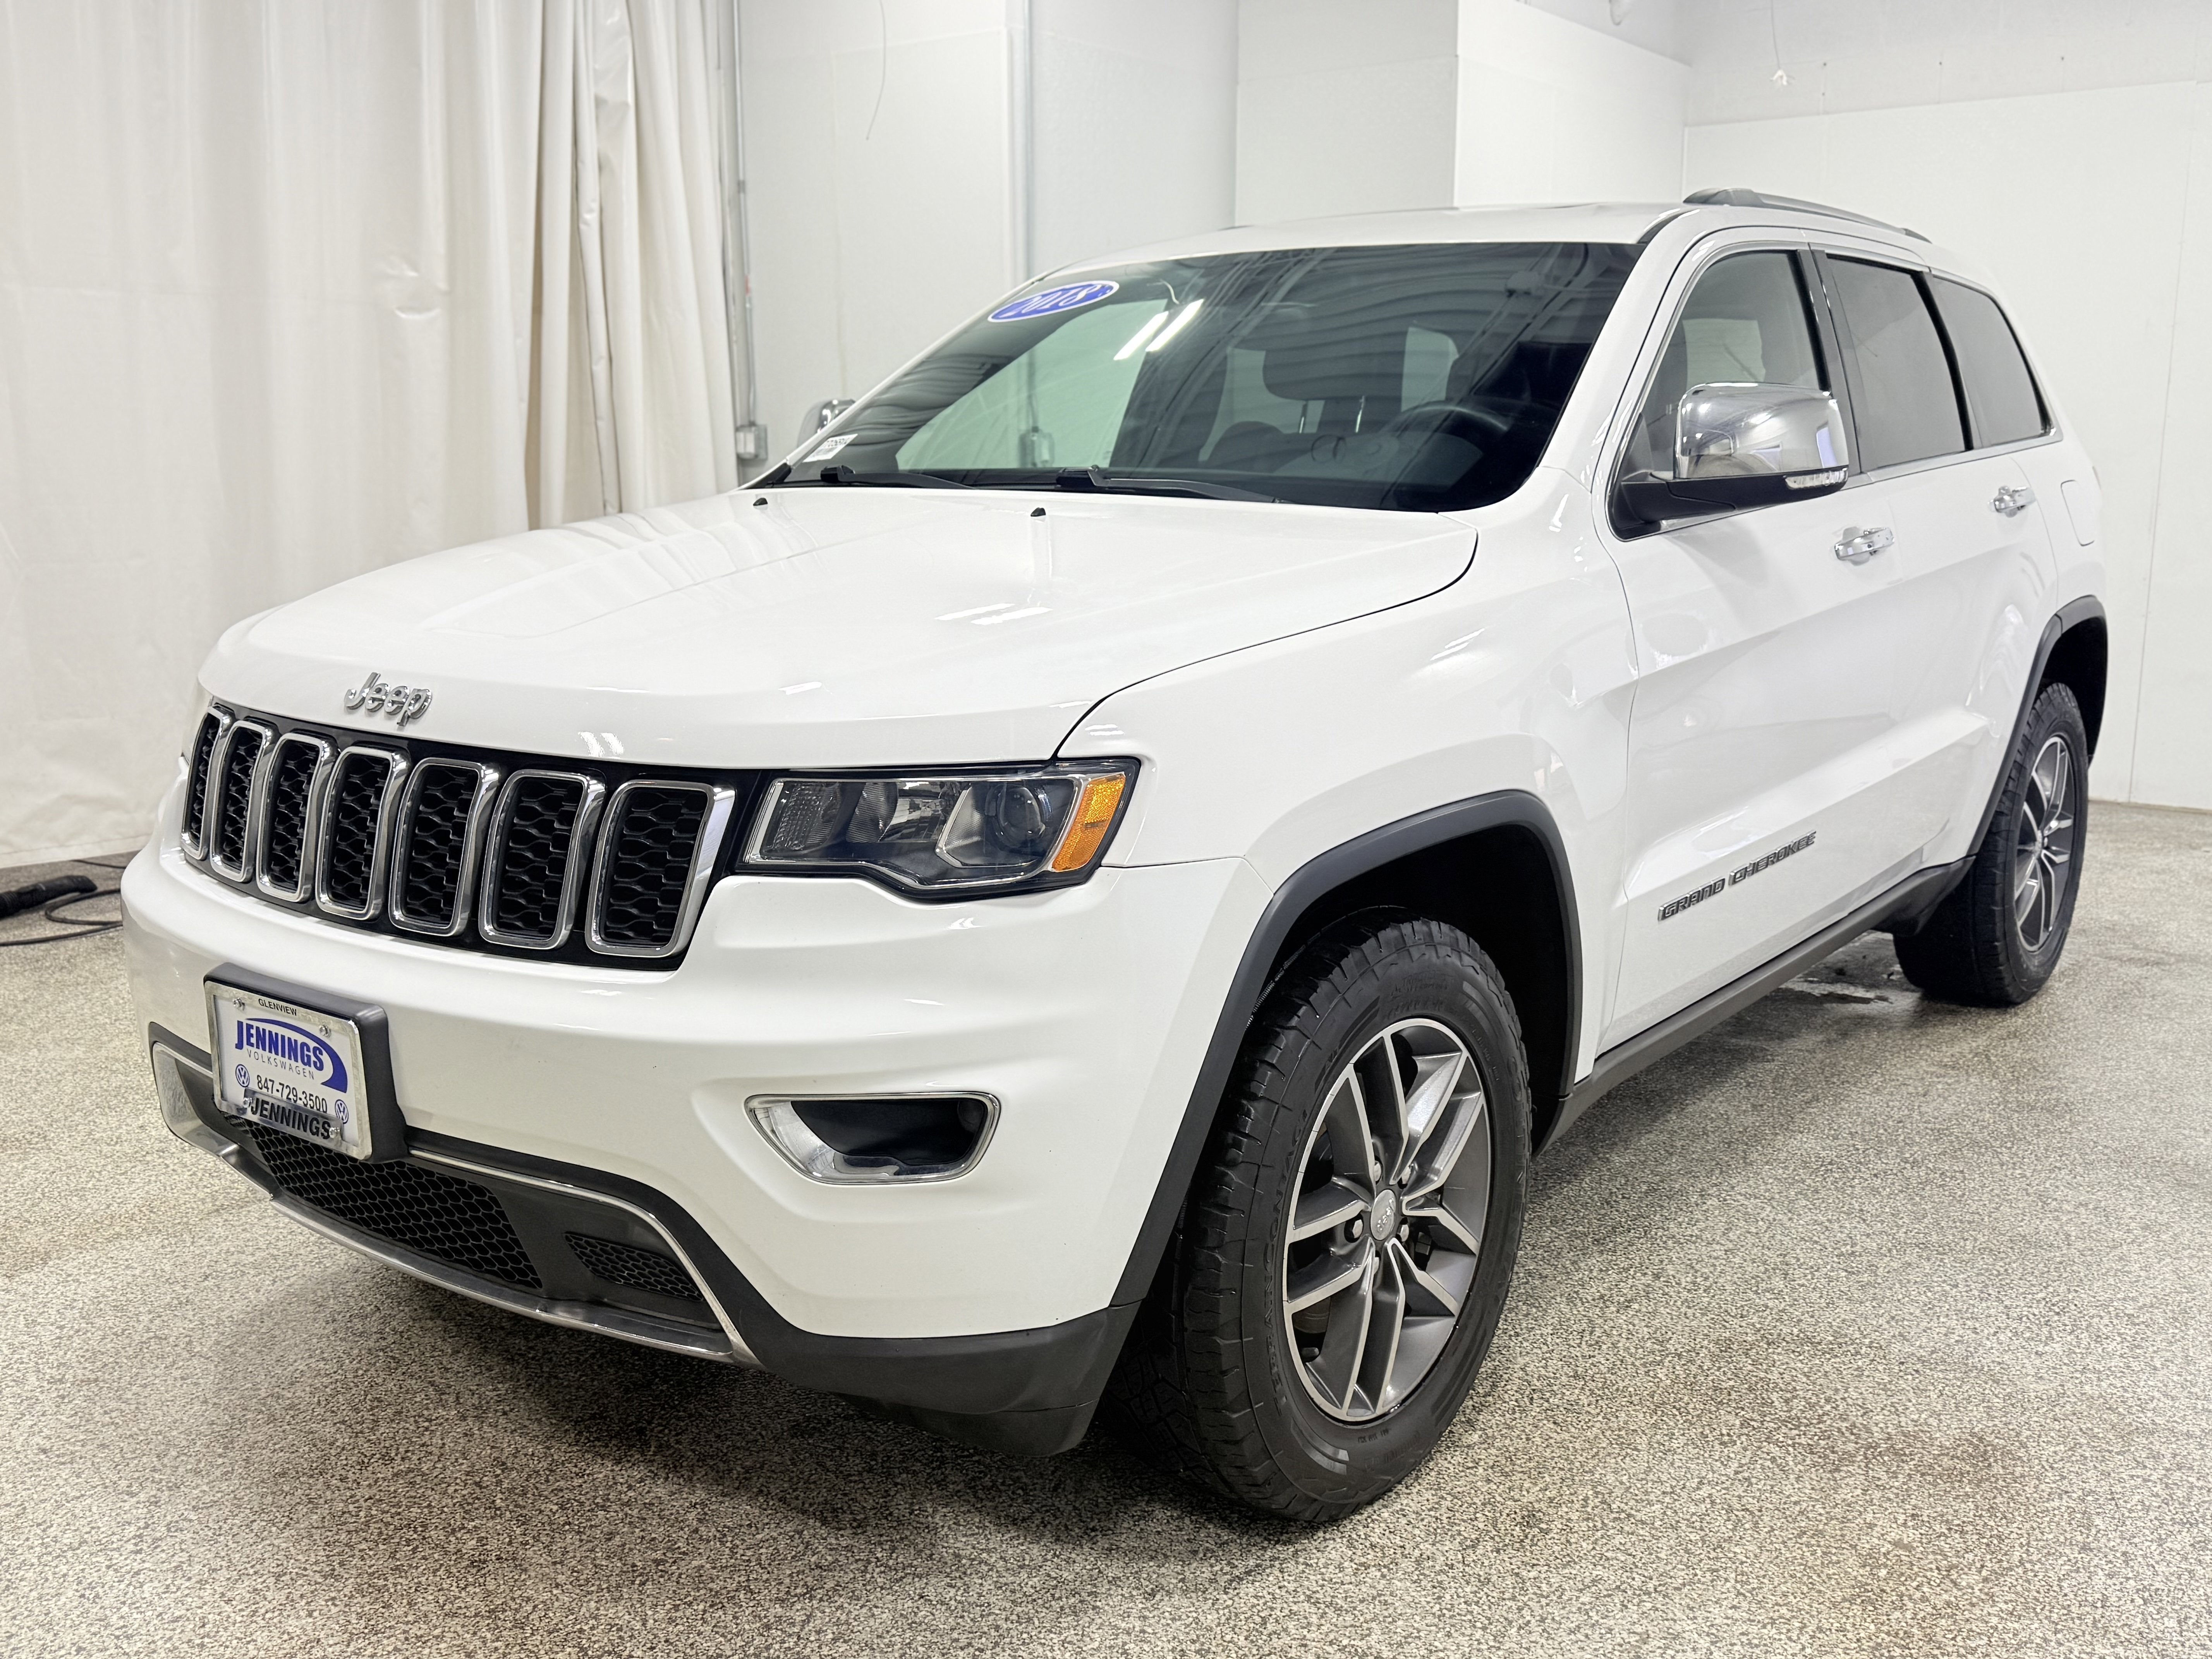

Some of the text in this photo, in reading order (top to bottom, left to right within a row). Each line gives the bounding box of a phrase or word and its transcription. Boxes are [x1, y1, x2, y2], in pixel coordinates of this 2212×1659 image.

[999, 284, 1103, 318] 2018
[344, 672, 432, 726] Jeep
[1658, 830, 1816, 921] GRAND CHEROKEE
[258, 998, 297, 1016] GLENVIEW
[235, 1020, 324, 1071] JENNINGS
[247, 1049, 314, 1080] VOLKSWAGEN
[257, 1075, 327, 1113] 847-729-3500
[251, 1097, 331, 1140] JENNINGS
